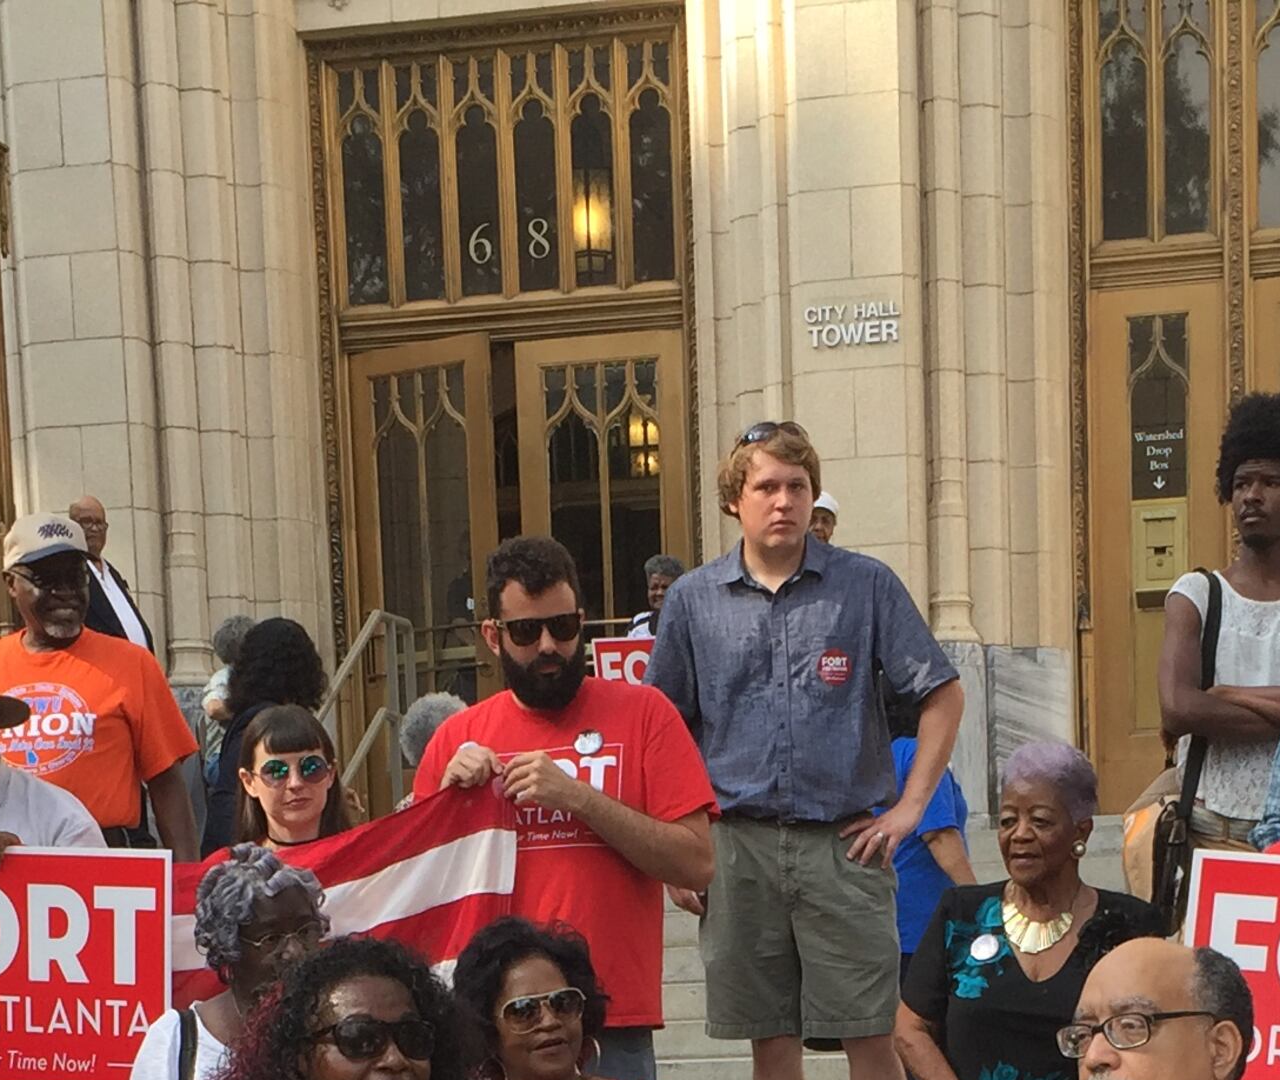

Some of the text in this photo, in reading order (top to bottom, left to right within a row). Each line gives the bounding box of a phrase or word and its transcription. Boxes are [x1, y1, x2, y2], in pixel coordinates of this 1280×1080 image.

[468, 217, 551, 265] 68
[804, 300, 900, 324] CITY HALL
[807, 319, 899, 348] TOWER
[1134, 428, 1184, 442] Watershed
[1146, 445, 1173, 459] Drop
[1149, 460, 1169, 471] Box
[600, 651, 651, 685] FO
[821, 656, 848, 667] FORT
[7, 1049, 47, 1071] Time
[52, 1053, 97, 1073] Now!
